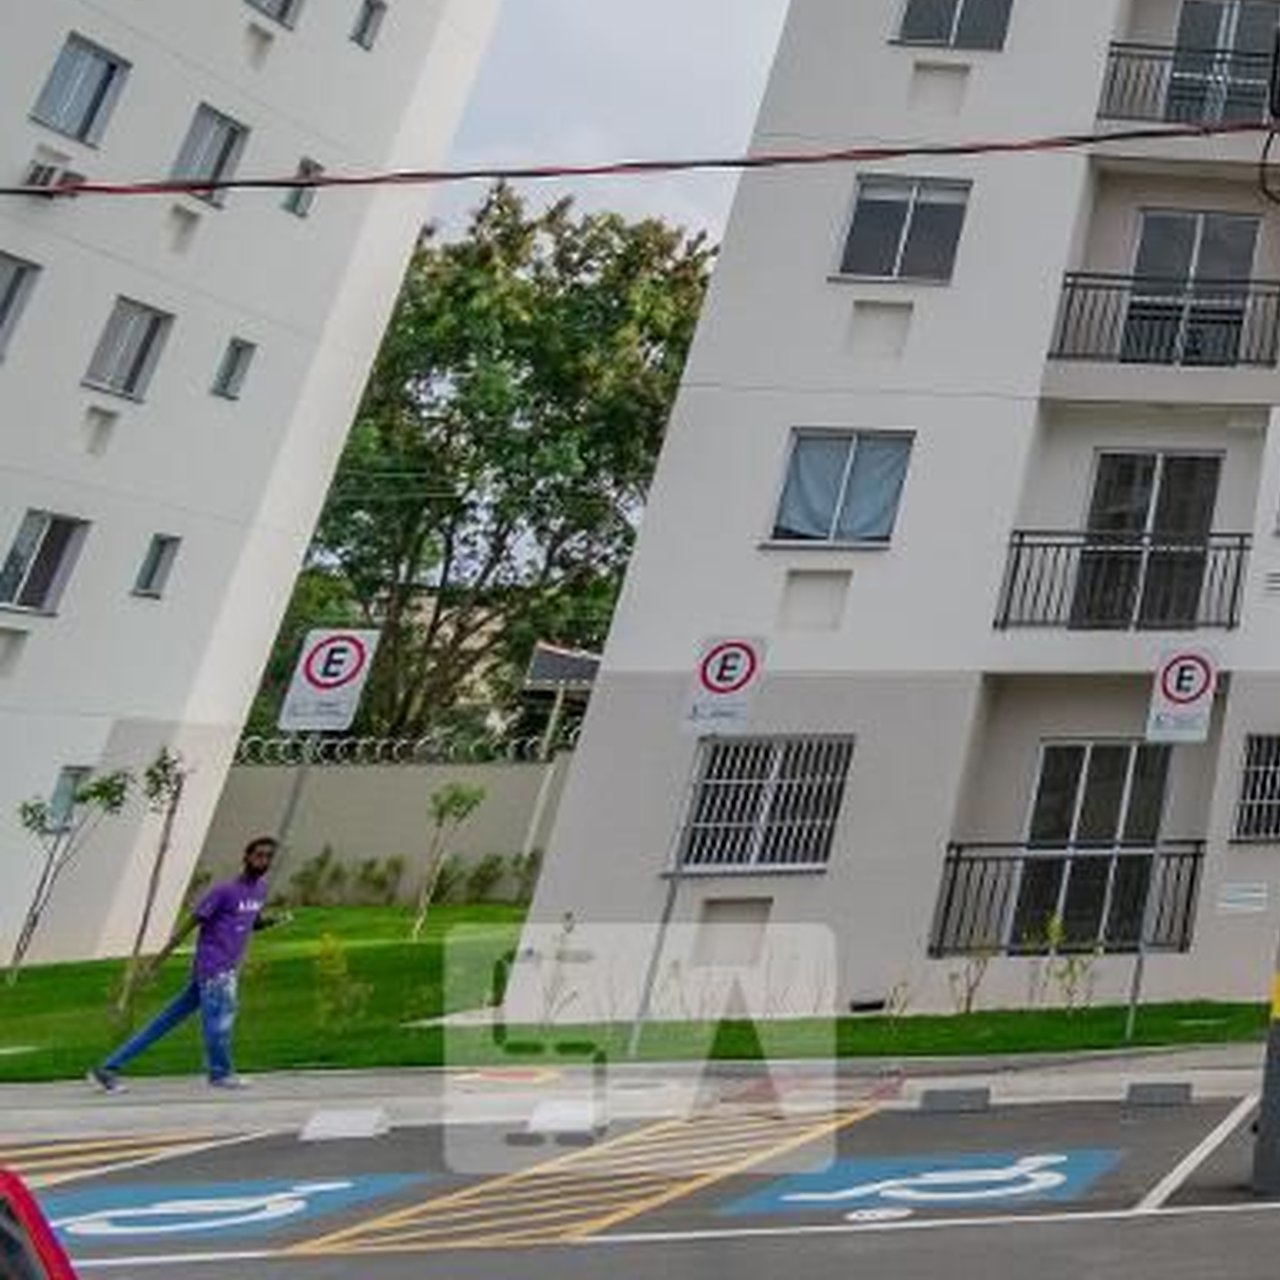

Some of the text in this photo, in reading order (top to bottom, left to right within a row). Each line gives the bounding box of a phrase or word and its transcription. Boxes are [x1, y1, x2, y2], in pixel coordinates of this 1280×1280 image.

[321, 647, 348, 677] E
[715, 651, 741, 682] E
[1175, 664, 1198, 693] E
